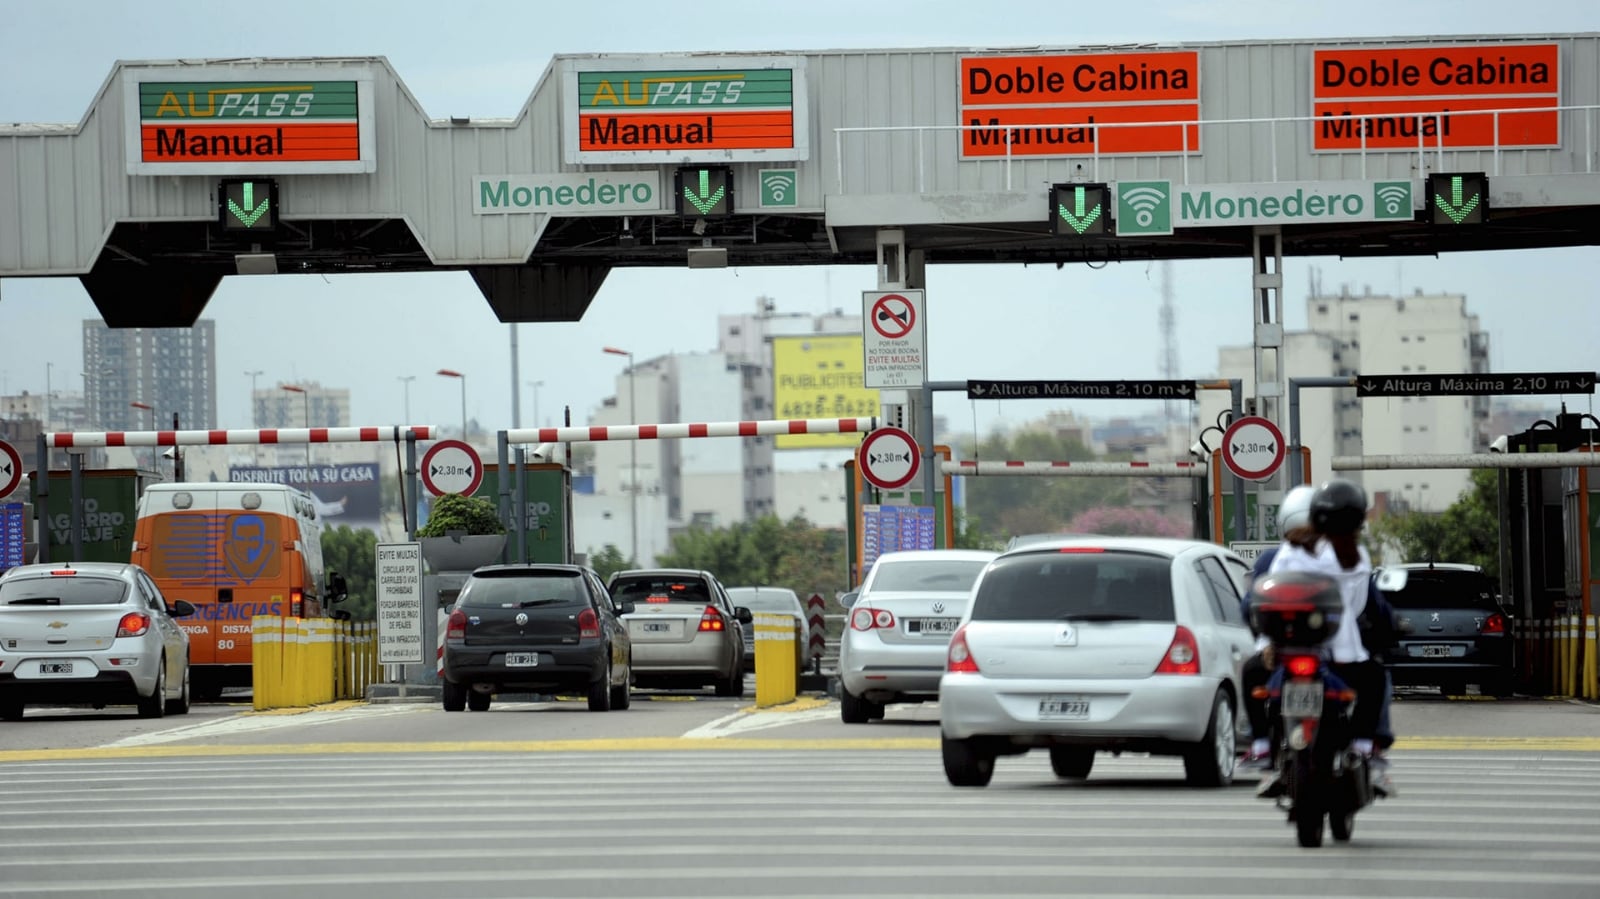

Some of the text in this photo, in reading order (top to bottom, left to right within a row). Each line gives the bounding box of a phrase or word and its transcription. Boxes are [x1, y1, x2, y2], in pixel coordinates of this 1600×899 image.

[968, 62, 1189, 95] Doble Cabina
[1322, 56, 1549, 88] Doble Cabina
[589, 117, 713, 146] Manual
[970, 116, 1095, 146] Manual
[1322, 109, 1450, 139] Manual
[156, 128, 284, 157] Manual
[479, 178, 653, 208] Monedero
[1180, 188, 1364, 220] Monedero
[868, 355, 920, 364] EVITE MULTAS
[989, 383, 1174, 396] Altura Máxima 2,10 m
[1383, 377, 1570, 392] Altura Máxima 2,10 m
[1240, 443, 1267, 454] 2,30 m
[877, 453, 903, 463] 2,30 m
[340, 466, 373, 481] CASA
[438, 466, 465, 476] 2,30 m
[379, 550, 418, 560] EVITE MULTAS
[217, 640, 234, 650] 80
